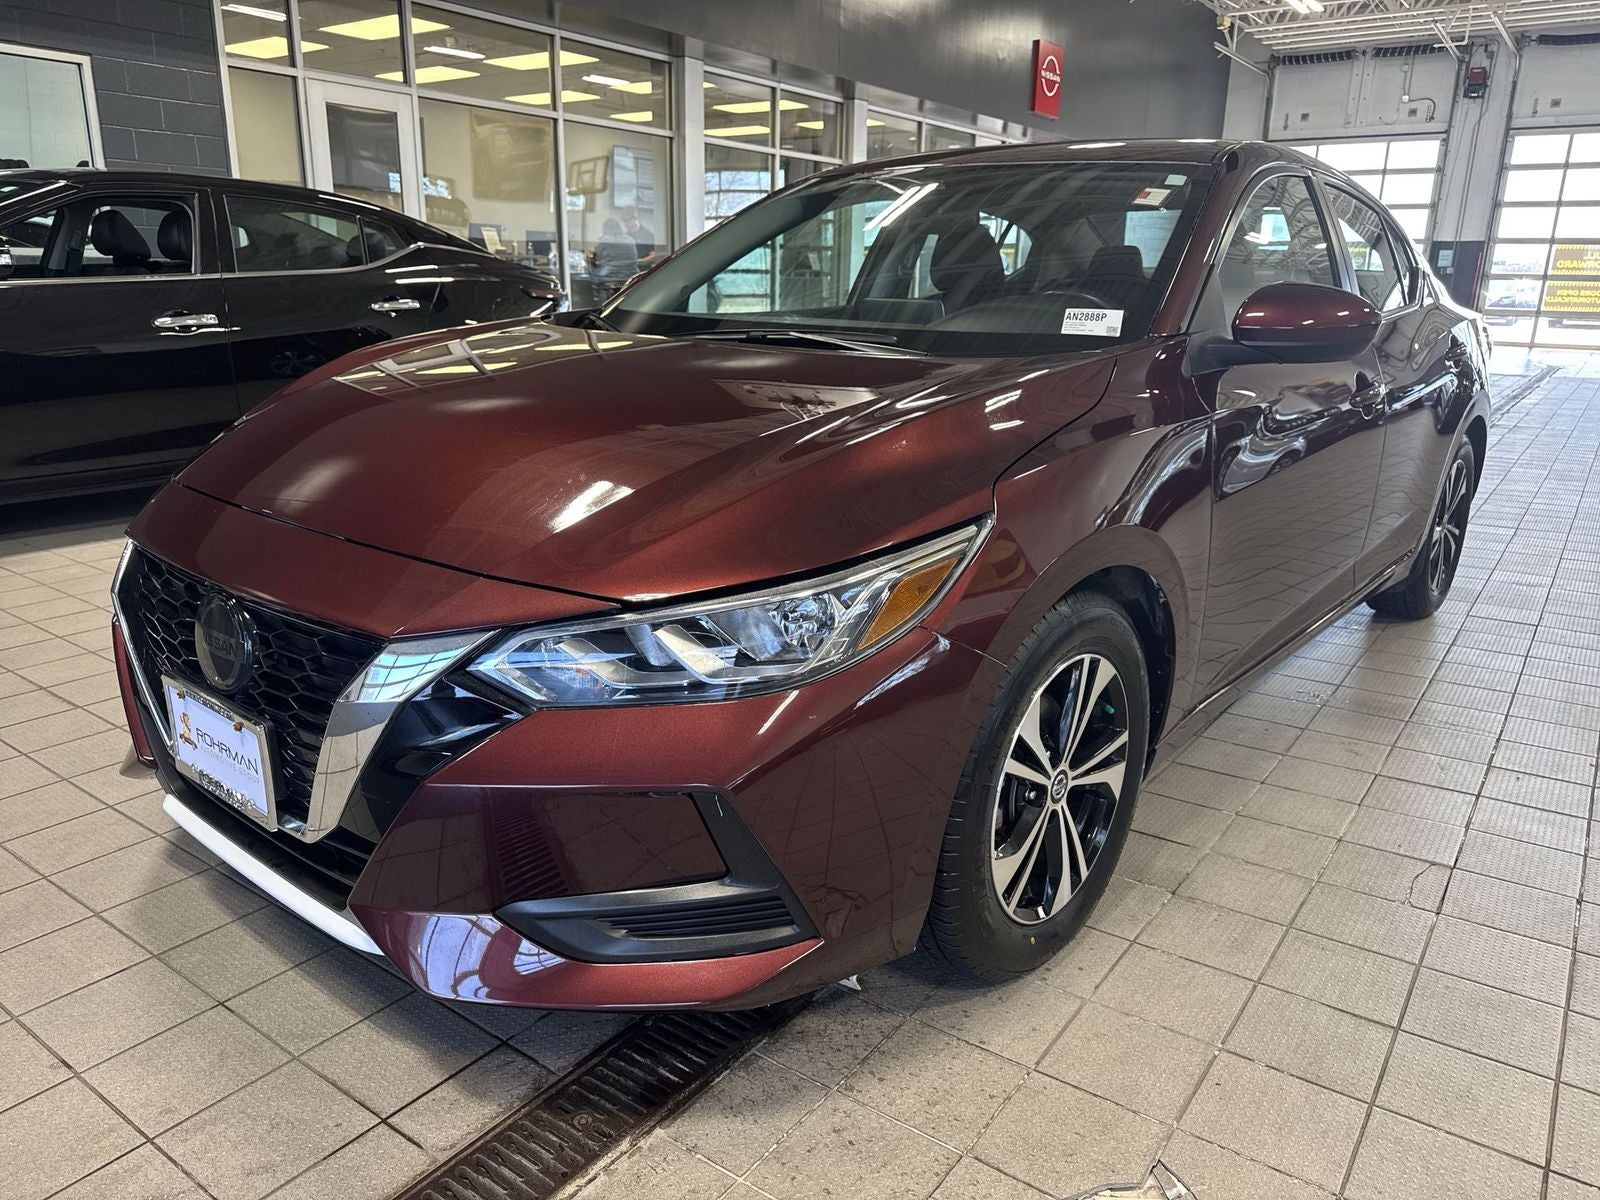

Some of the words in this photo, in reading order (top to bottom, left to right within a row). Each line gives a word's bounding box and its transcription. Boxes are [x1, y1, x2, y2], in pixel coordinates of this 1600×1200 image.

[1041, 69, 1060, 82] NISSAN
[1065, 312, 1107, 321] AN2888P
[196, 727, 259, 775] ROHRMAN
